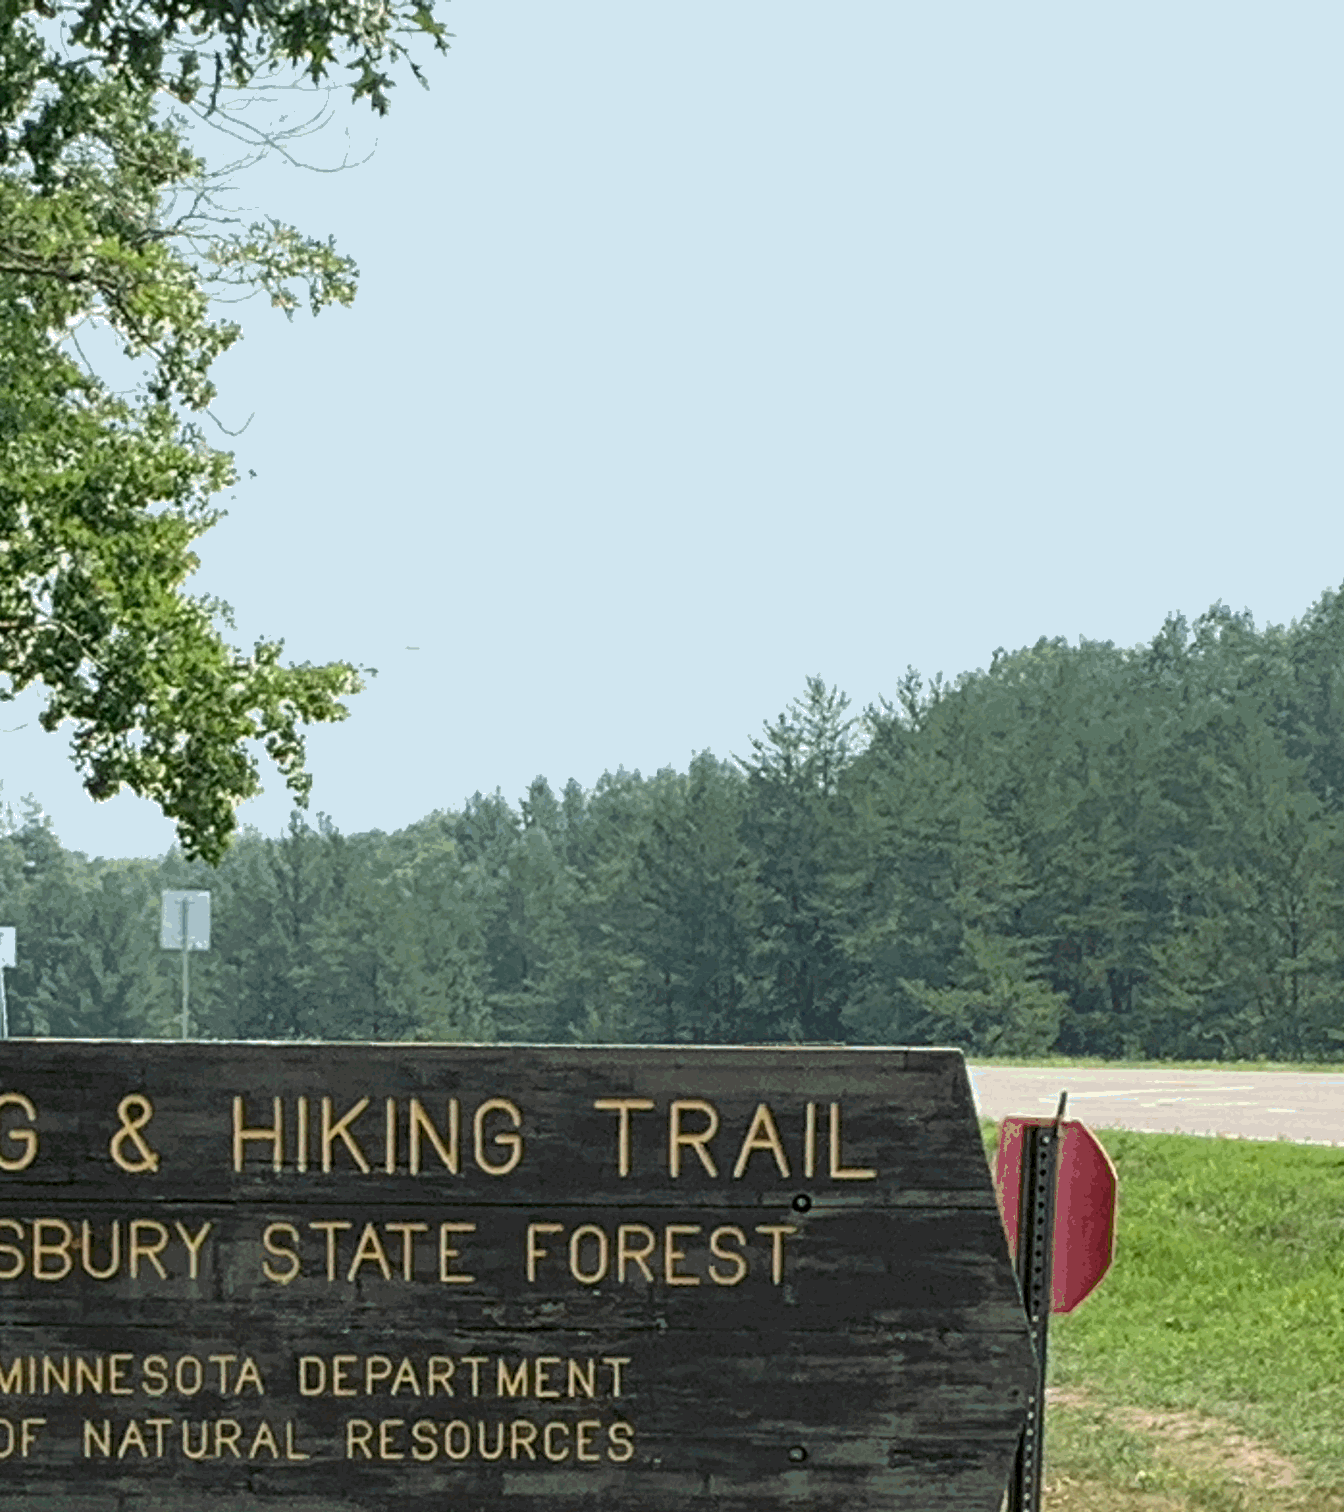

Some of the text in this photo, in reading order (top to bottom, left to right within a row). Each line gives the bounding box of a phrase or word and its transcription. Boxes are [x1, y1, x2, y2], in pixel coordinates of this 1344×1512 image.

[109, 1093, 159, 1173] &
[232, 1095, 522, 1175] HIKING
[595, 1099, 877, 1180] TRAIL
[262, 1221, 476, 1285] STATE
[527, 1223, 797, 1286] FOREST
[300, 1355, 631, 1398] DEPARTMENT
[82, 1418, 309, 1460] NATURAL
[346, 1420, 635, 1462] RESOURCES
